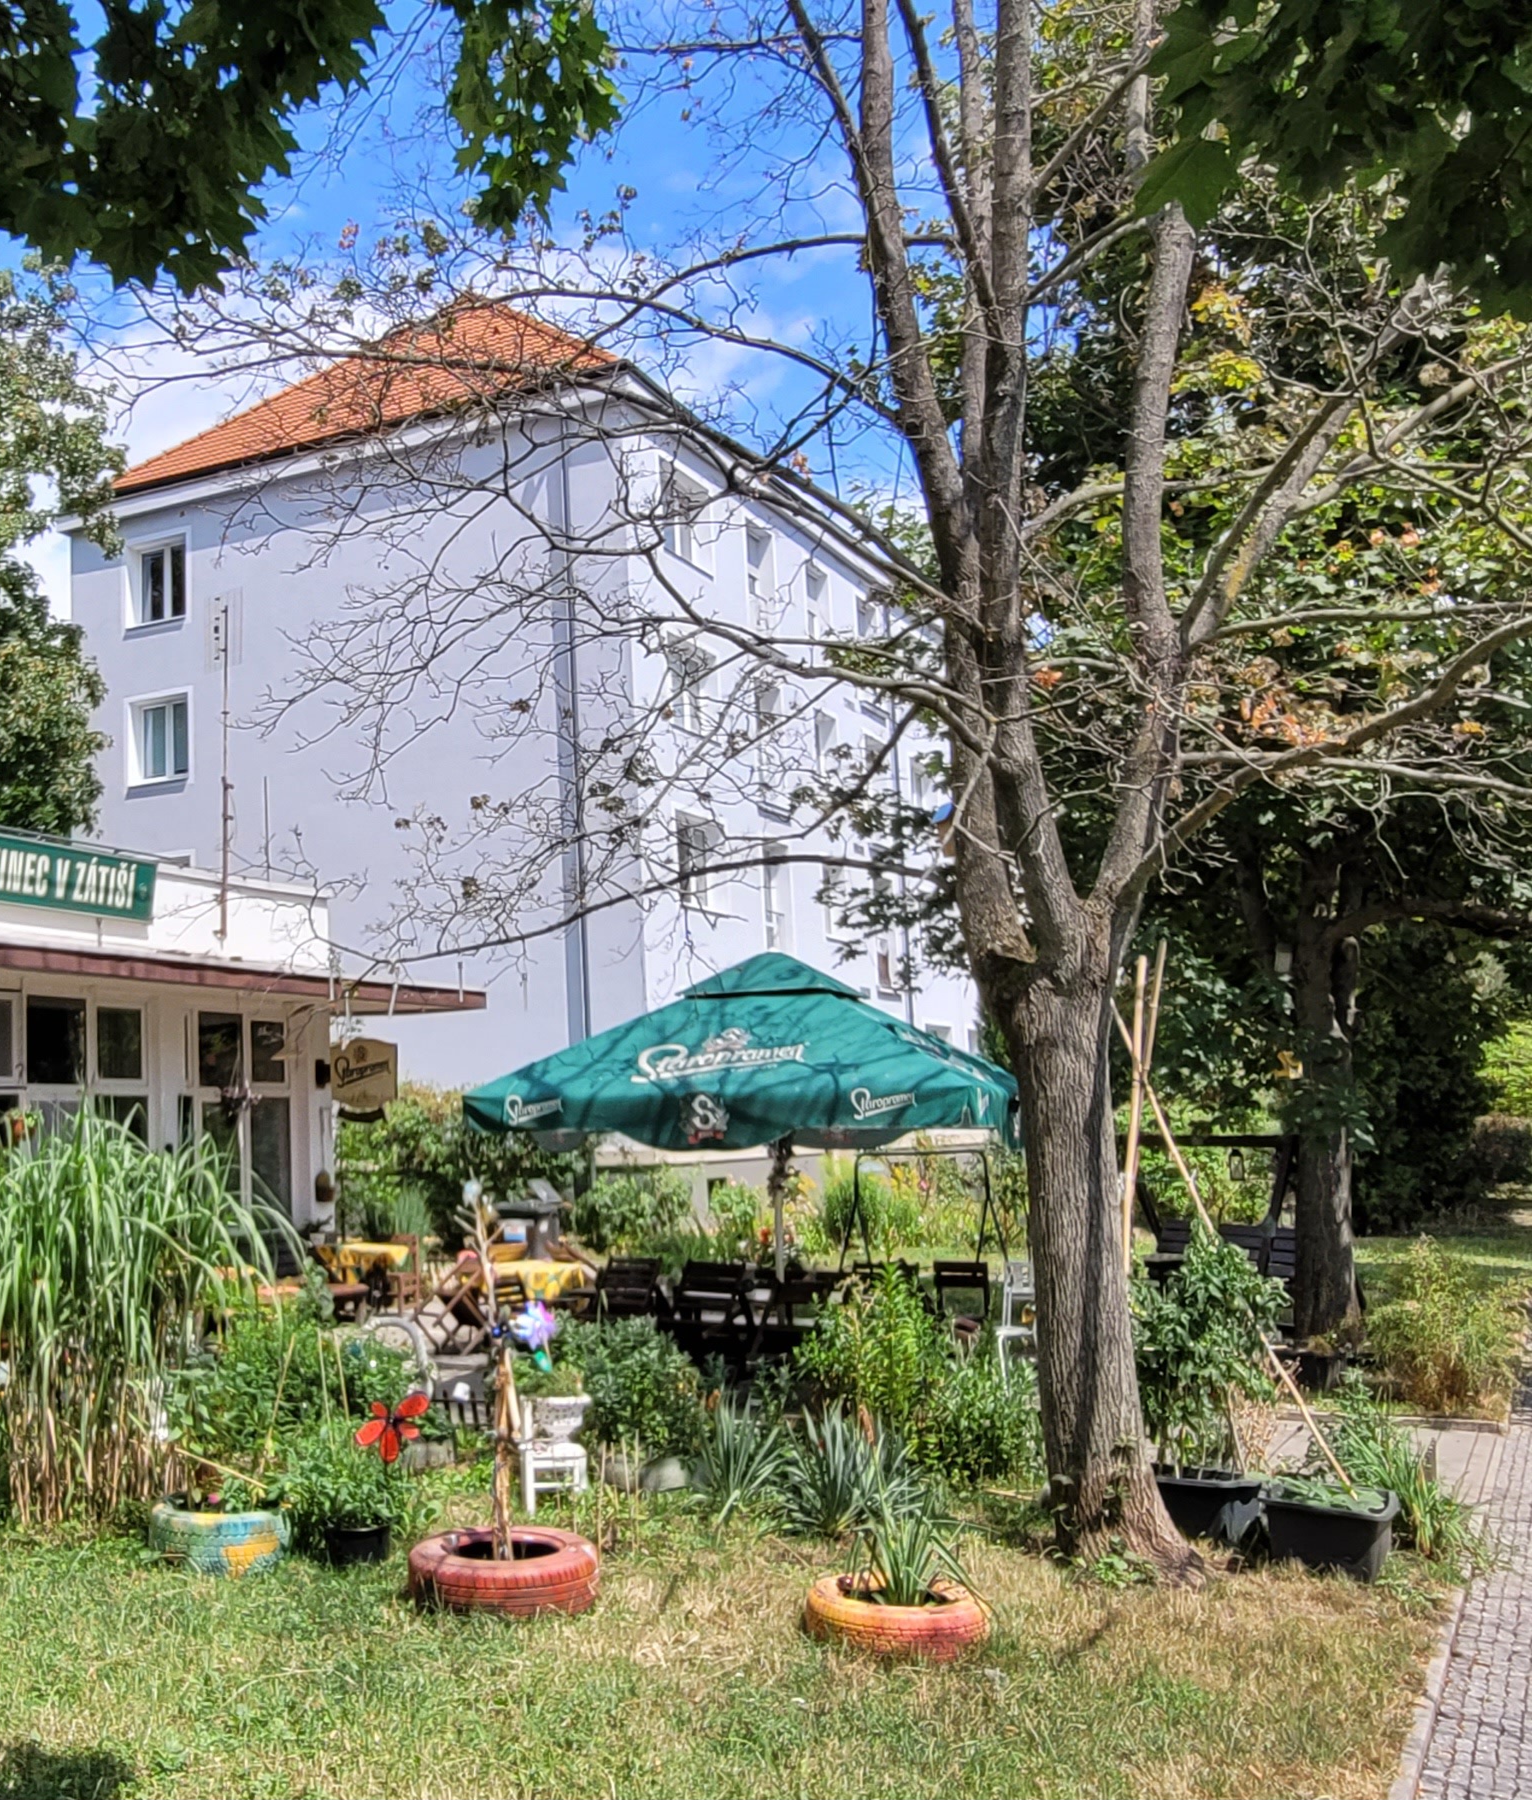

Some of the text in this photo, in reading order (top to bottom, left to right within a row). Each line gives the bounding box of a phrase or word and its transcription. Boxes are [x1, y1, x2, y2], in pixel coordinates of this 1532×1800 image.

[55, 857, 70, 899] V
[72, 857, 138, 910] ZÁTIŠÍ
[631, 1042, 806, 1085] Staropramen
